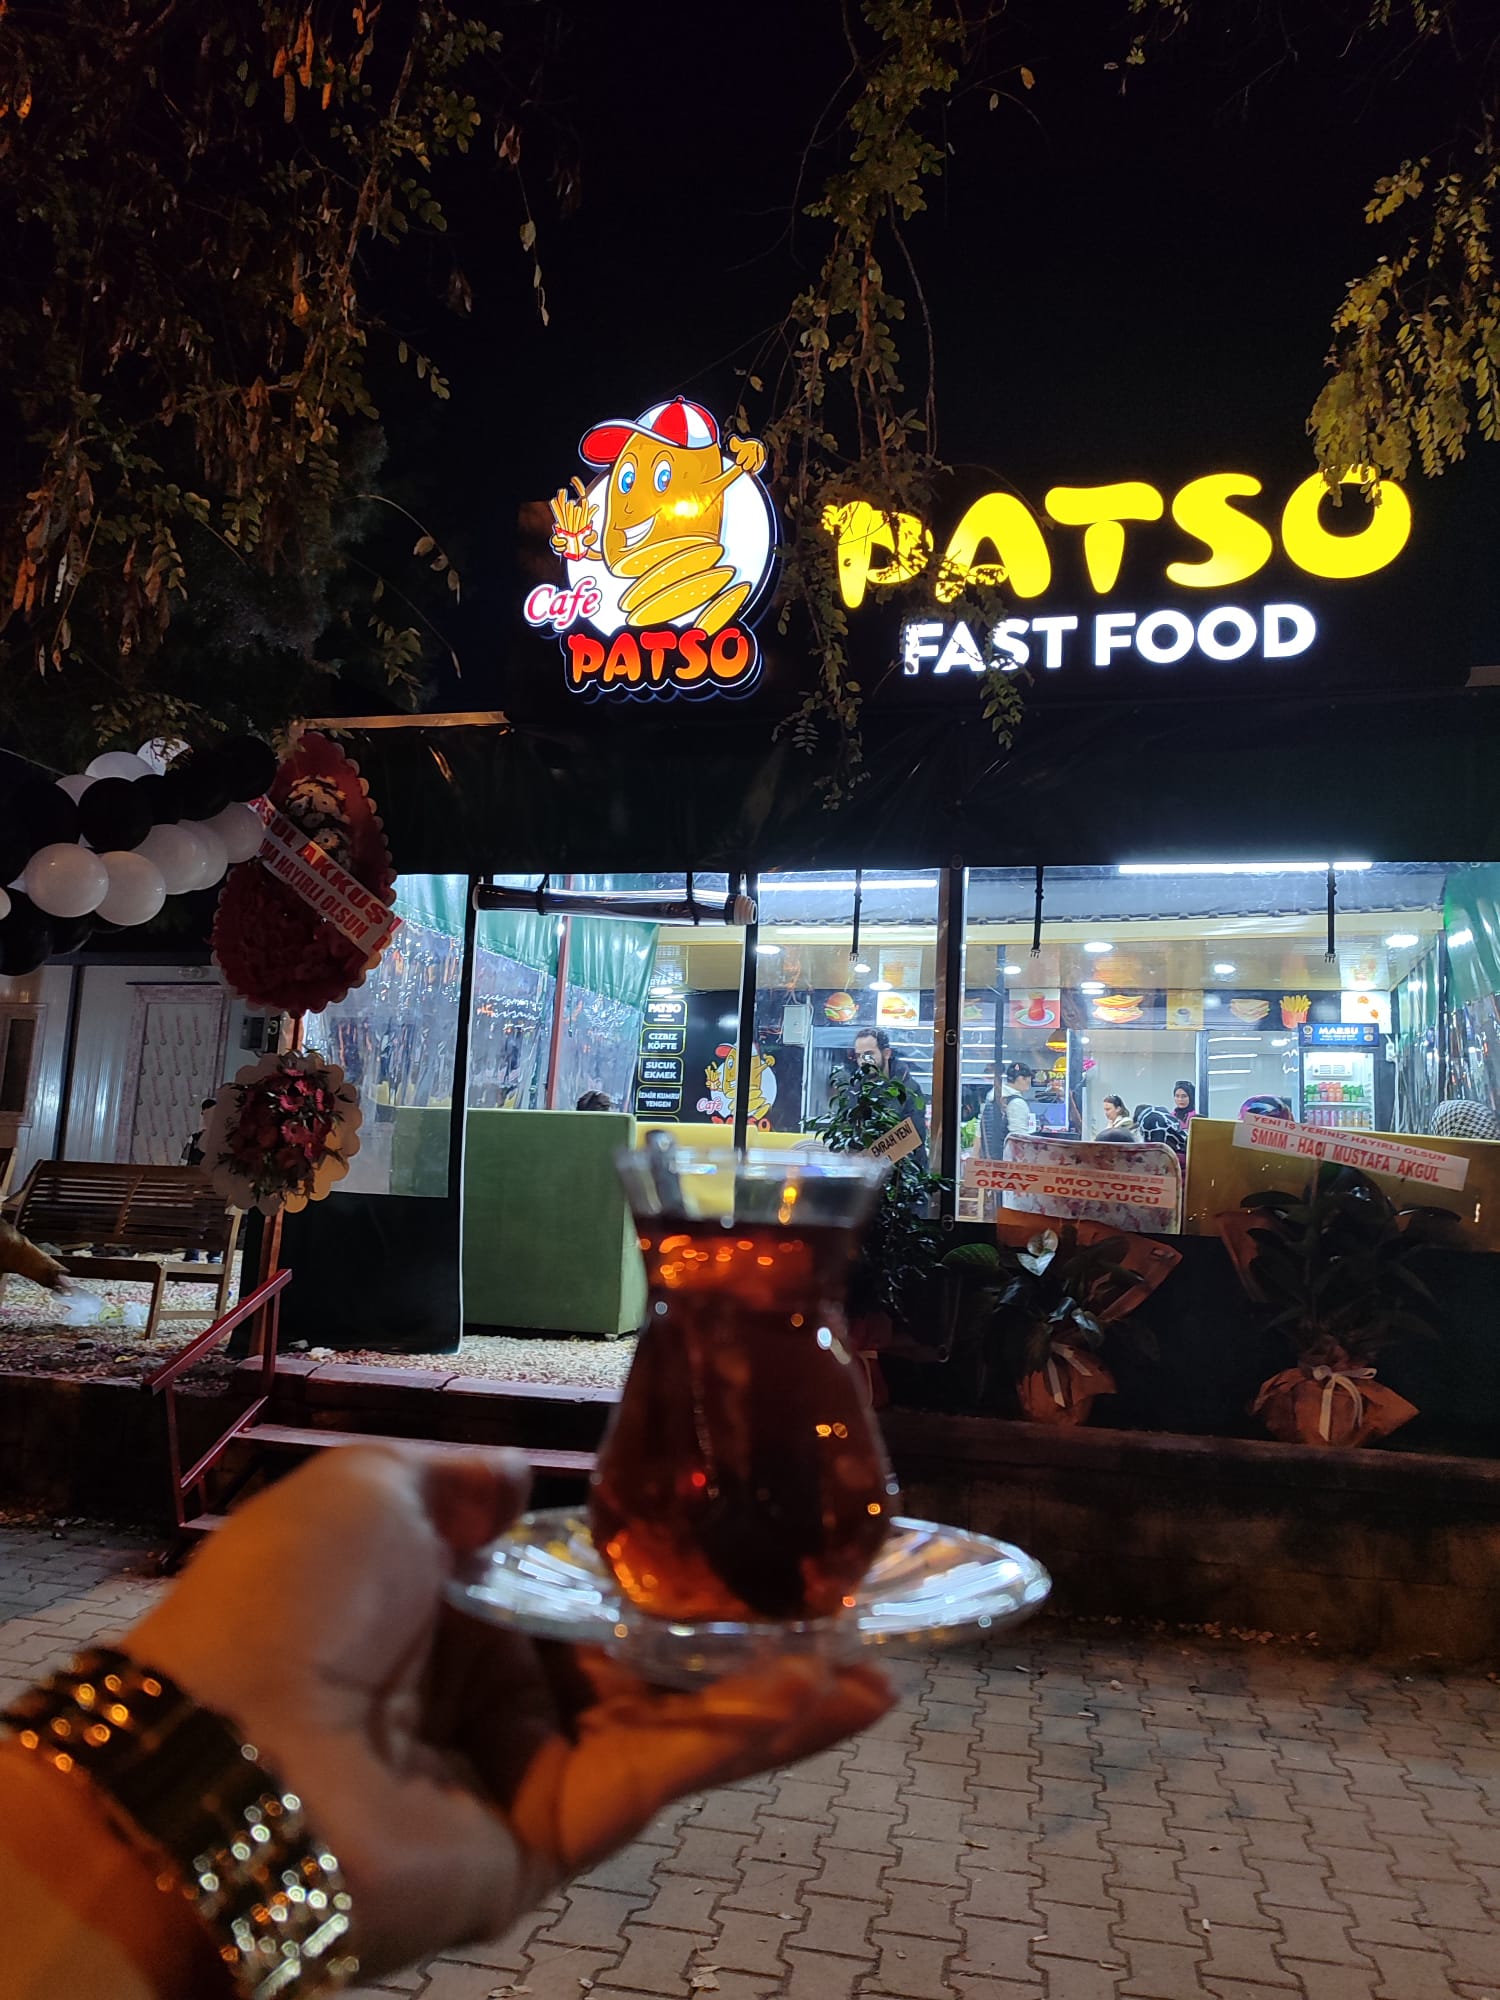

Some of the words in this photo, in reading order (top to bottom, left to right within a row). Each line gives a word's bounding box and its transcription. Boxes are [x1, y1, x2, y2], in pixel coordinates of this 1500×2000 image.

[820, 463, 1412, 608] PATSO
[526, 580, 599, 627] Cafe
[903, 615, 1078, 674] FAST
[1094, 604, 1317, 666] FOOD
[567, 627, 749, 683] PATSO
[274, 855, 326, 902] HAYIRLI
[319, 894, 370, 940] OLSUN
[647, 1041, 678, 1050] KÖFTE
[644, 1071, 677, 1080] EKMEK
[645, 1061, 677, 1070] SUCUK
[697, 1098, 723, 1114] Cafe
[871, 1133, 898, 1157] EMRAH
[1333, 1144, 1391, 1172] MUSTAFA
[1351, 1136, 1401, 1152] HAYIRLI
[1404, 1147, 1448, 1162] OLSUN
[975, 1168, 1040, 1183] ARAS
[1055, 1175, 1162, 1196] MOTORS
[976, 1179, 1031, 1191] OKAY
[1043, 1185, 1160, 1205] DOKUYUCU
